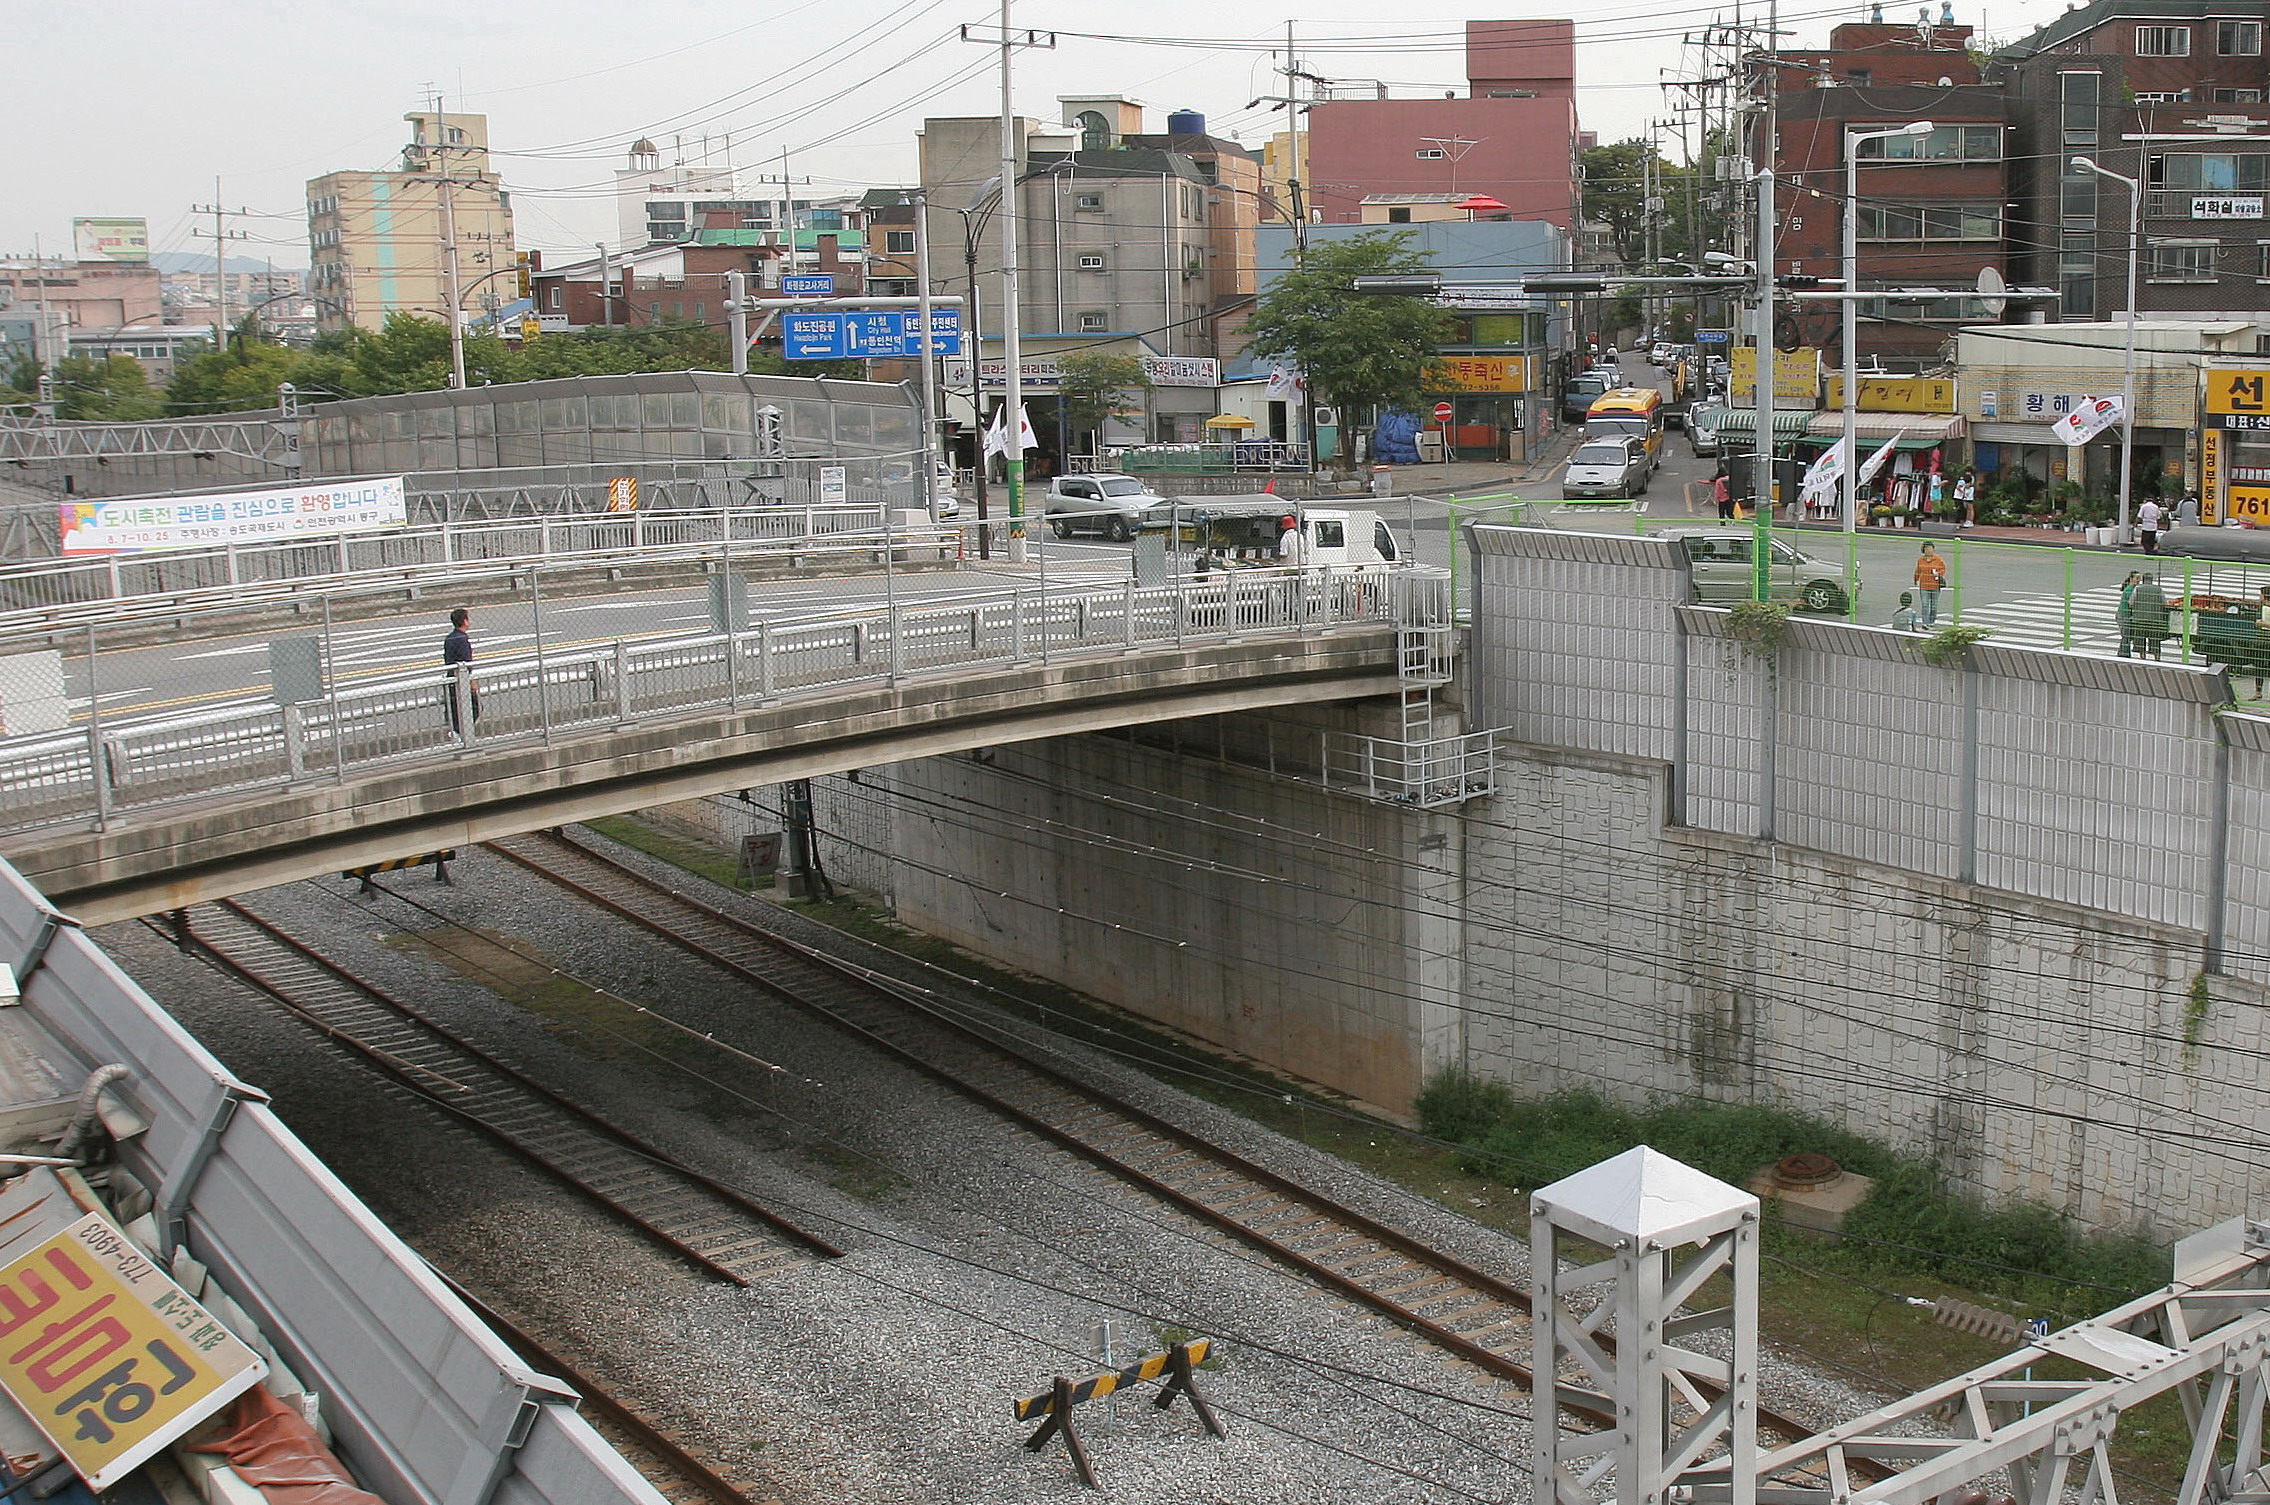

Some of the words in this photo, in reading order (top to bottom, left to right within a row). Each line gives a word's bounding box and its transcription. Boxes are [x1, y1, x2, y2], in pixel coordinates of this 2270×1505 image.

[792, 319, 836, 333] 화도진공원
[867, 315, 888, 327] 시청
[819, 332, 833, 341] Park
[868, 335, 903, 347] 동인천역
[2204, 436, 2216, 517] 선정부동산
[104, 506, 172, 528] 도시축전
[177, 502, 227, 524] 관람을
[231, 497, 295, 518] 진심으로
[300, 488, 378, 513] 환영합니다
[307, 513, 356, 529] 인천광역시
[359, 510, 379, 523] 동구
[79, 1222, 153, 1285] 773-4903
